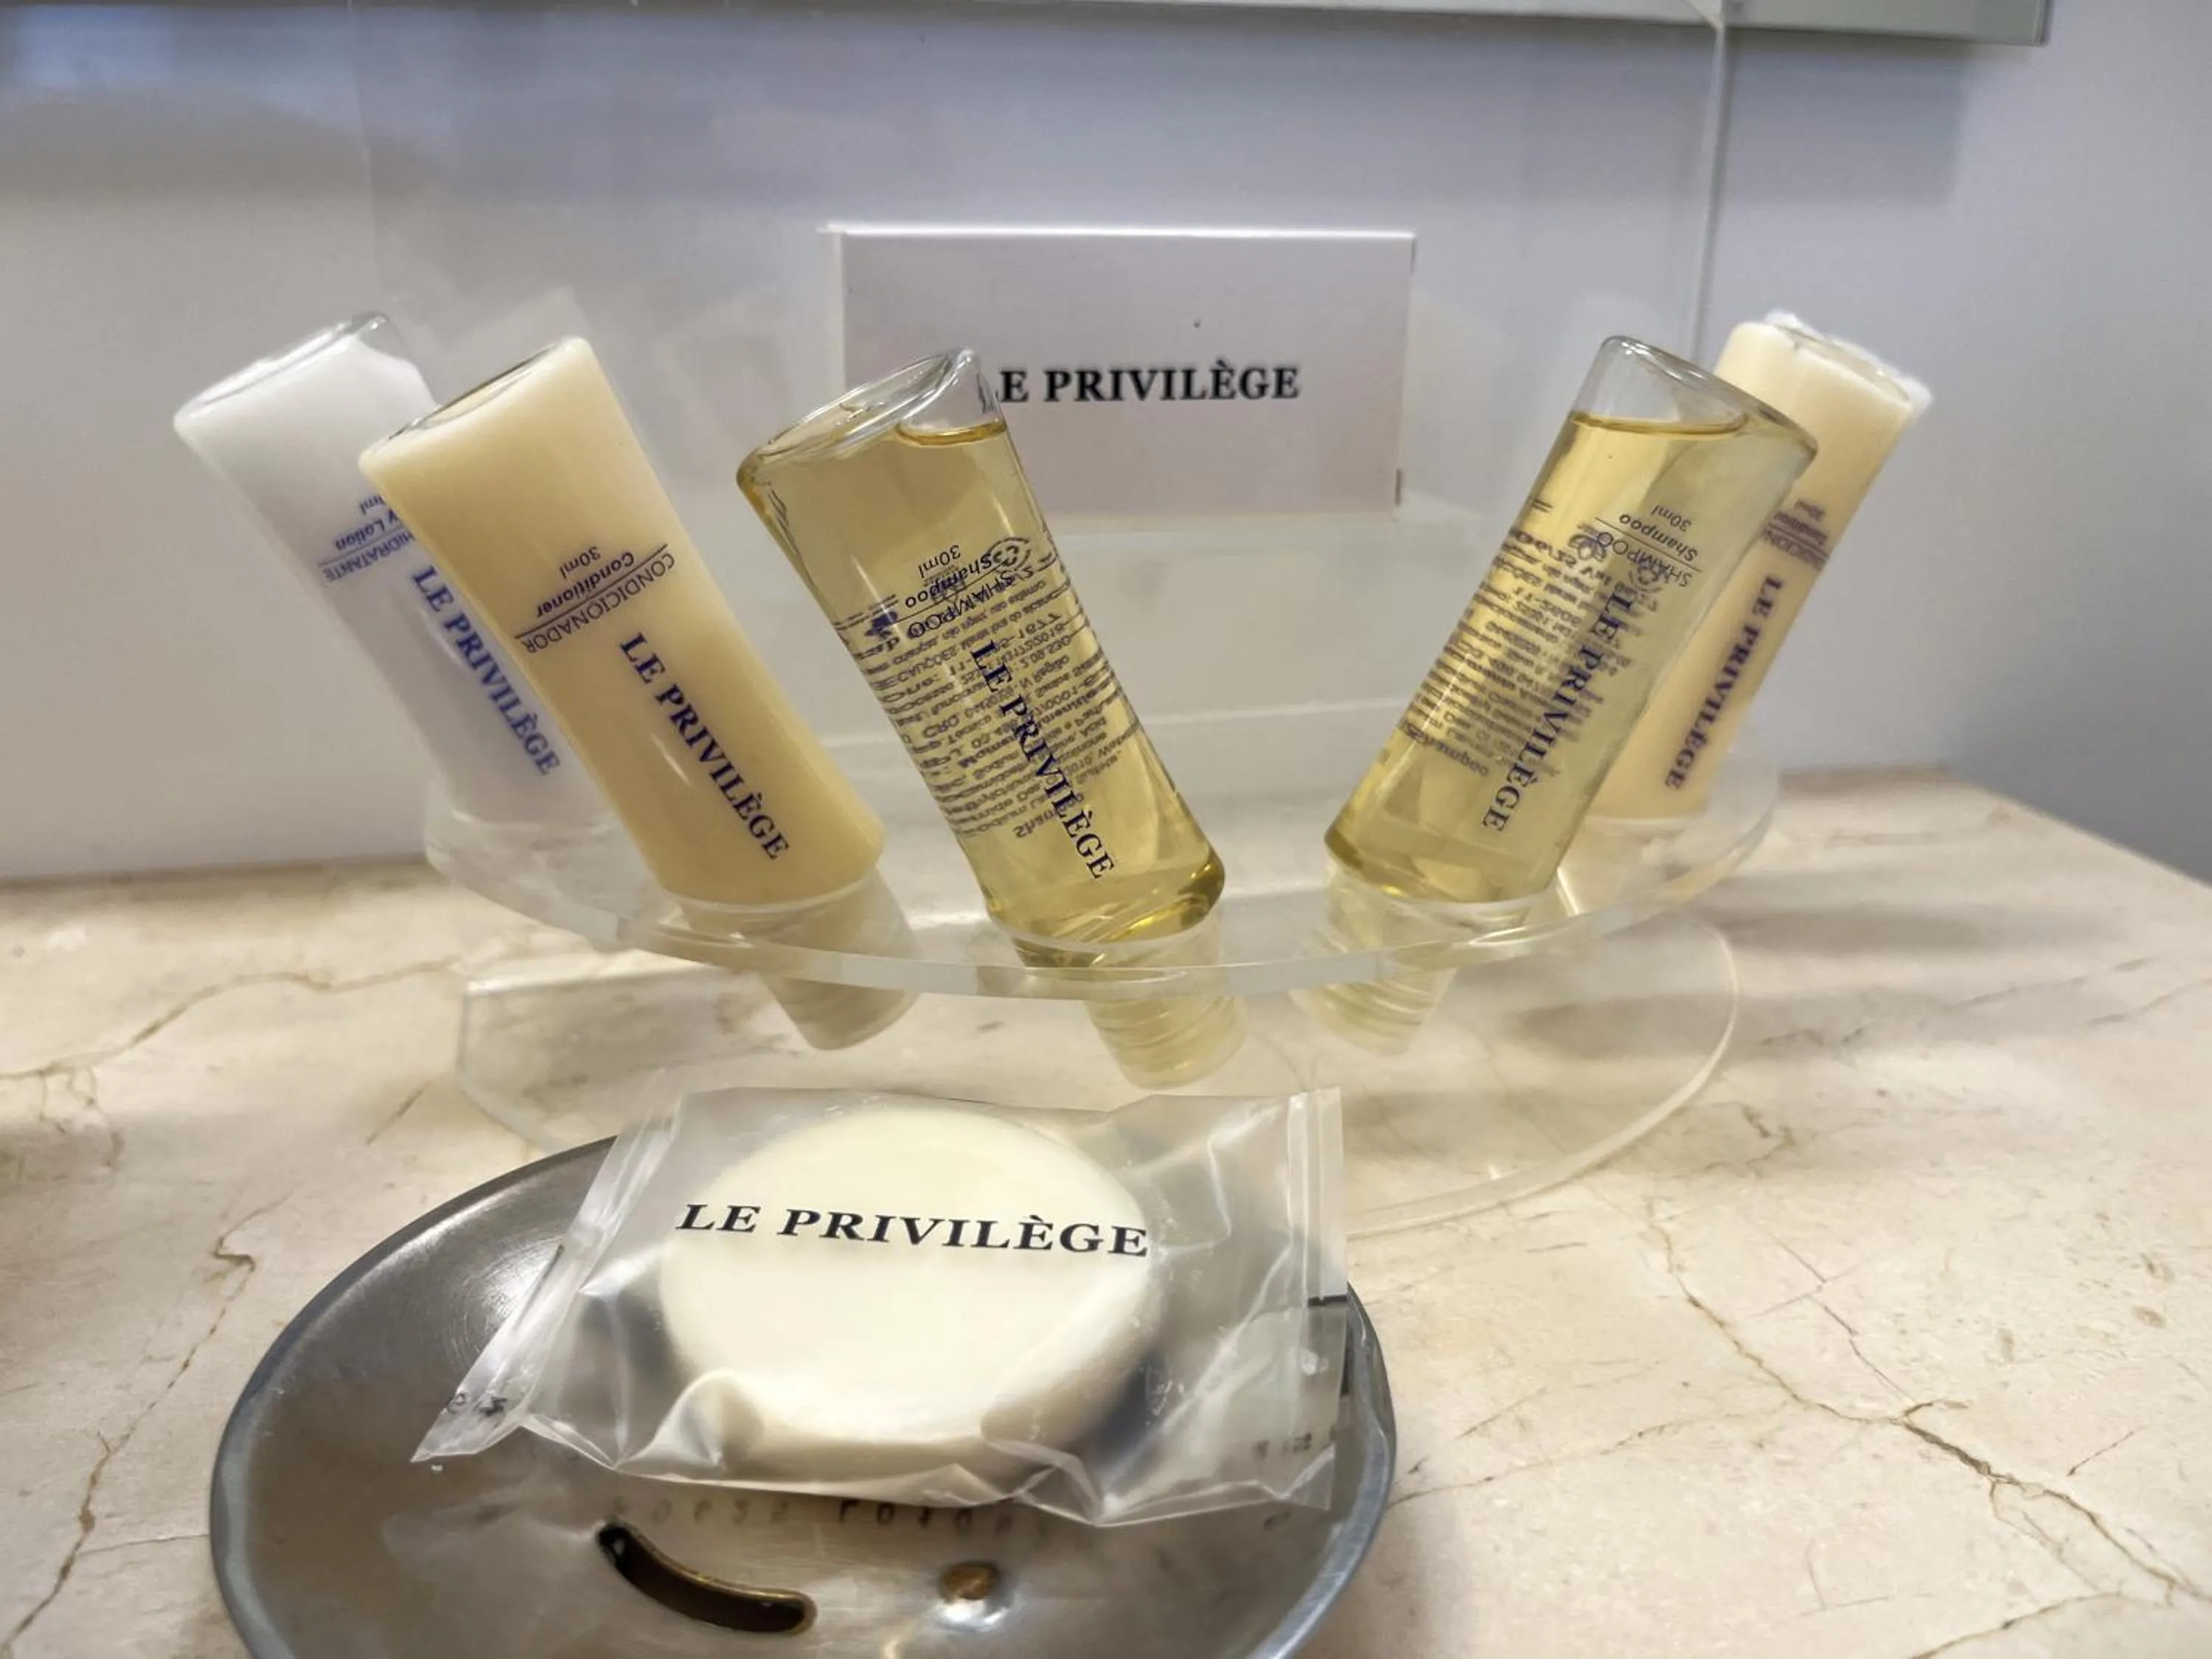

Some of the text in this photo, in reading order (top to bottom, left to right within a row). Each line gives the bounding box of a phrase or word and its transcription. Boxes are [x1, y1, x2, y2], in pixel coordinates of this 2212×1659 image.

[1043, 357, 1300, 403] PRIVILÈGE
[333, 518, 386, 554] Lotion
[1618, 512, 1698, 563] Shampoo
[1650, 504, 1691, 532] 30ml
[534, 550, 636, 619] Conditioner
[557, 544, 602, 580] 30ml
[904, 553, 993, 609] Shampoo
[916, 543, 962, 578] 30ml
[1594, 529, 1691, 588] SHAMPOO
[520, 554, 675, 654] CONDICIONADOR
[906, 569, 1015, 640] SHAMPOO
[1592, 589, 1632, 644] LE
[411, 565, 562, 776] LE PRIVILÈGE
[1666, 575, 1784, 792] LE PRIVILÈGE
[620, 632, 790, 861] LE PRIVILÈGE
[970, 639, 1012, 693] LE
[1000, 695, 1114, 879] PRIVILÈGE
[1481, 643, 1607, 832] PRIVILÈGE
[676, 1204, 1151, 1259] LE PRIVILÈGE
